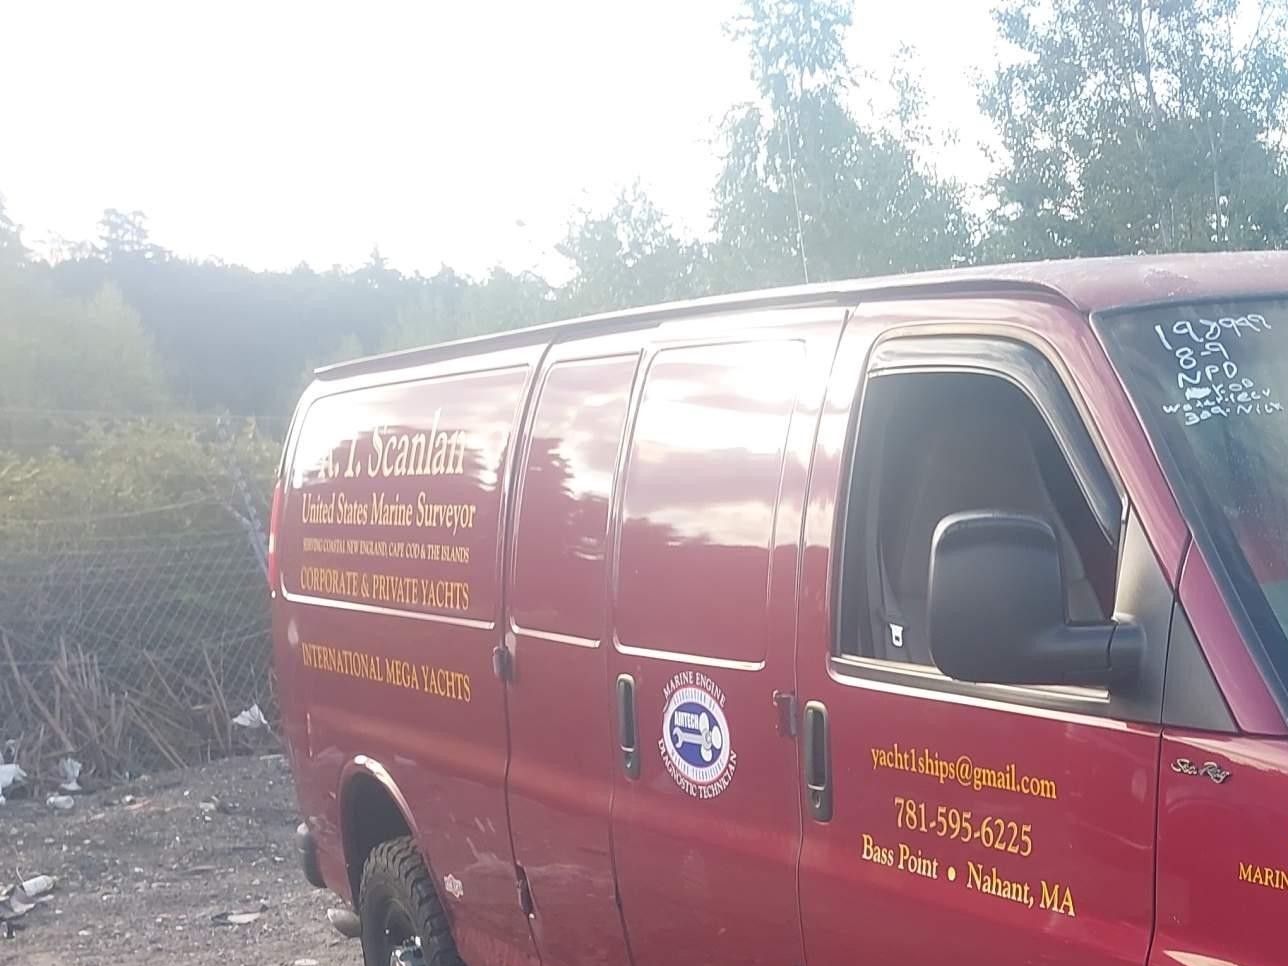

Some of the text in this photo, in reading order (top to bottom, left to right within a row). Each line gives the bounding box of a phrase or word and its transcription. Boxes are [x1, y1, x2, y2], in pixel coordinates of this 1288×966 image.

[367, 408, 466, 478] Scanlan
[302, 491, 476, 536] United States Marine Surveyor
[304, 537, 323, 553] VING
[405, 543, 420, 559] COD
[427, 544, 440, 561] THE
[441, 545, 470, 563] ISLANDS
[300, 566, 469, 610] CORPORATE & PRIVATE YACHTS
[302, 642, 471, 702] INTERNATIONAL MEGA YACHTS
[663, 671, 726, 708] MARINE ENGINE
[658, 738, 737, 799] DIAGNOSTIC TECHNICIAN
[871, 743, 1057, 799] yacht1ships@gmail.com
[894, 797, 1033, 857] 781-595-6225
[862, 834, 1075, 917] Bass Point Nahant, MA
